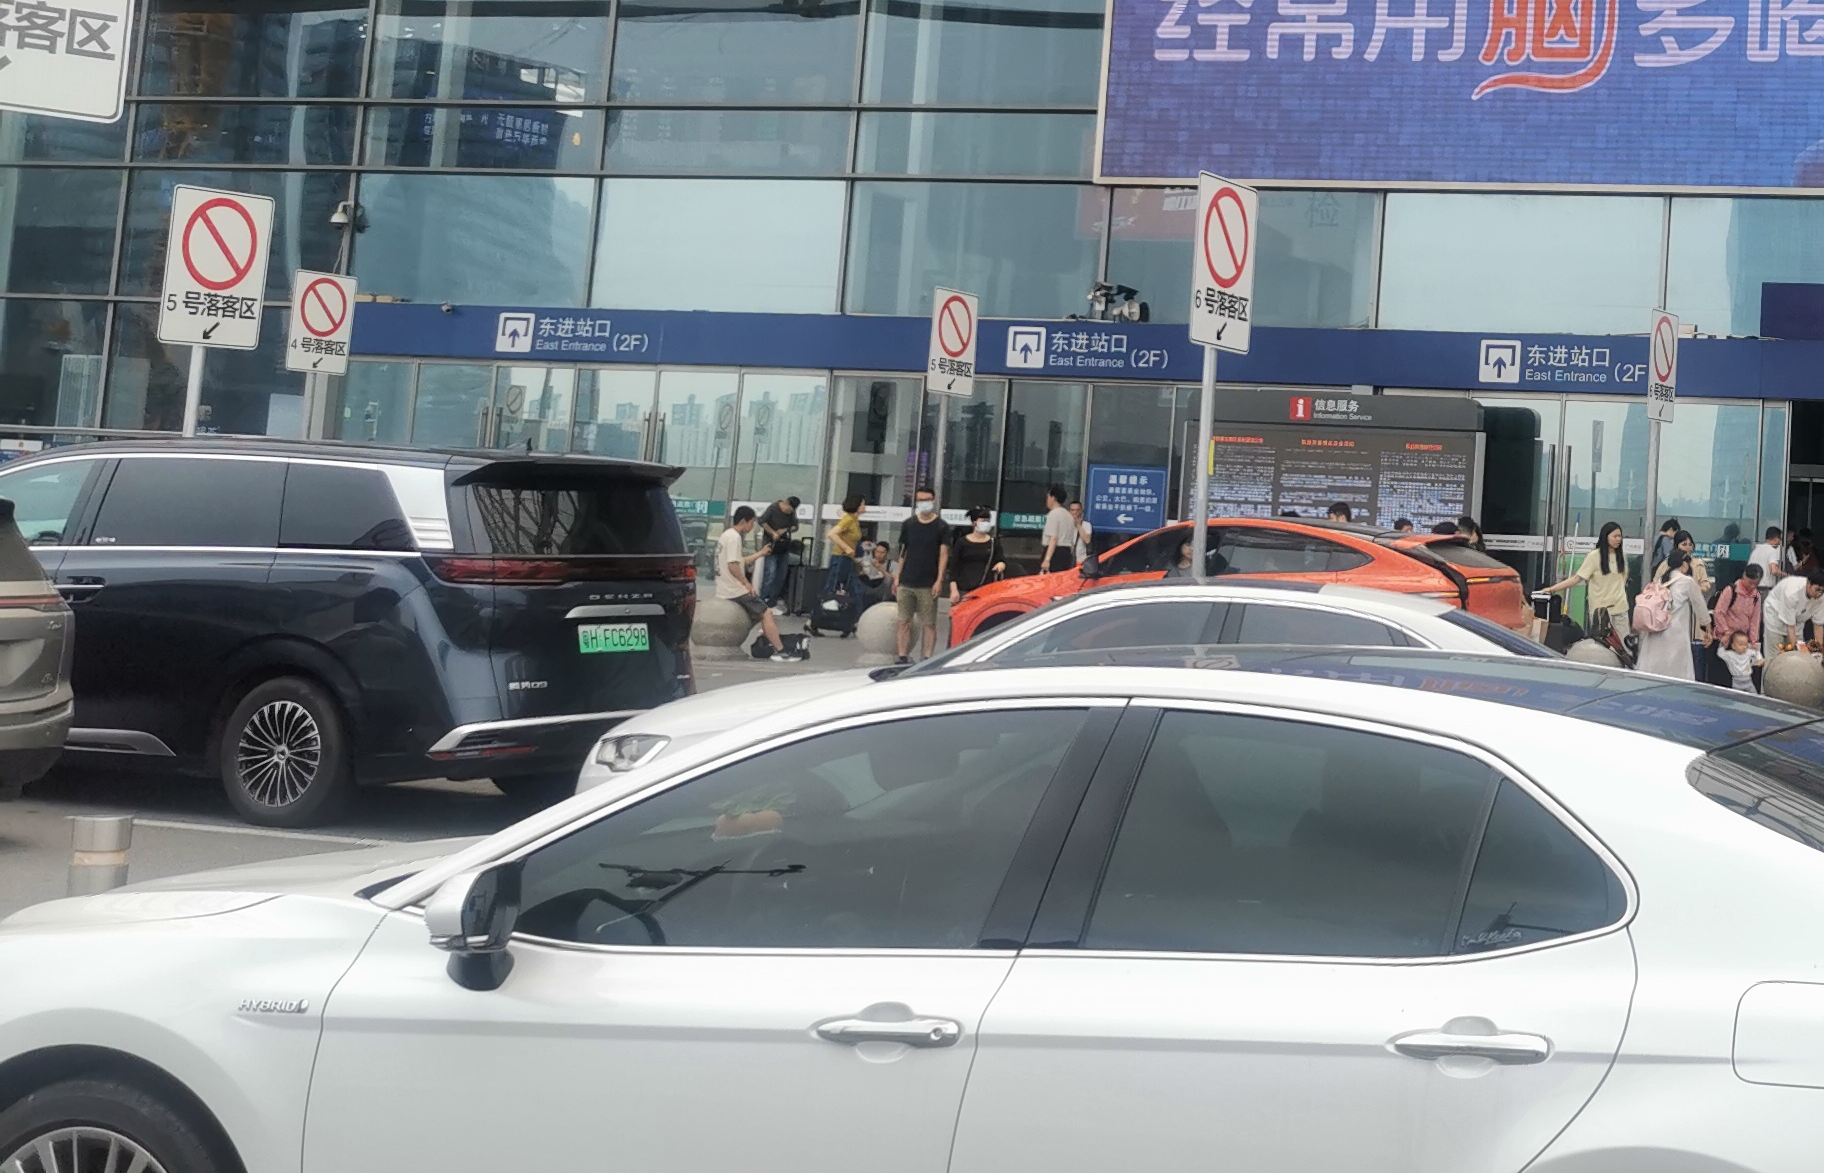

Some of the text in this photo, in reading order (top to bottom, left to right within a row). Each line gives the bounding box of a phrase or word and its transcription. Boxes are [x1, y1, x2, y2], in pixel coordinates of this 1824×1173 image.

[537, 316, 611, 338] 东进站口
[1051, 331, 1128, 353] 东进站口
[1049, 355, 1125, 368] East Entrance
[1526, 344, 1610, 367] 东进站口
[1525, 368, 1607, 383] East Entrance
[1314, 399, 1360, 413] 信息服务
[238, 998, 300, 1014] HYBRID
